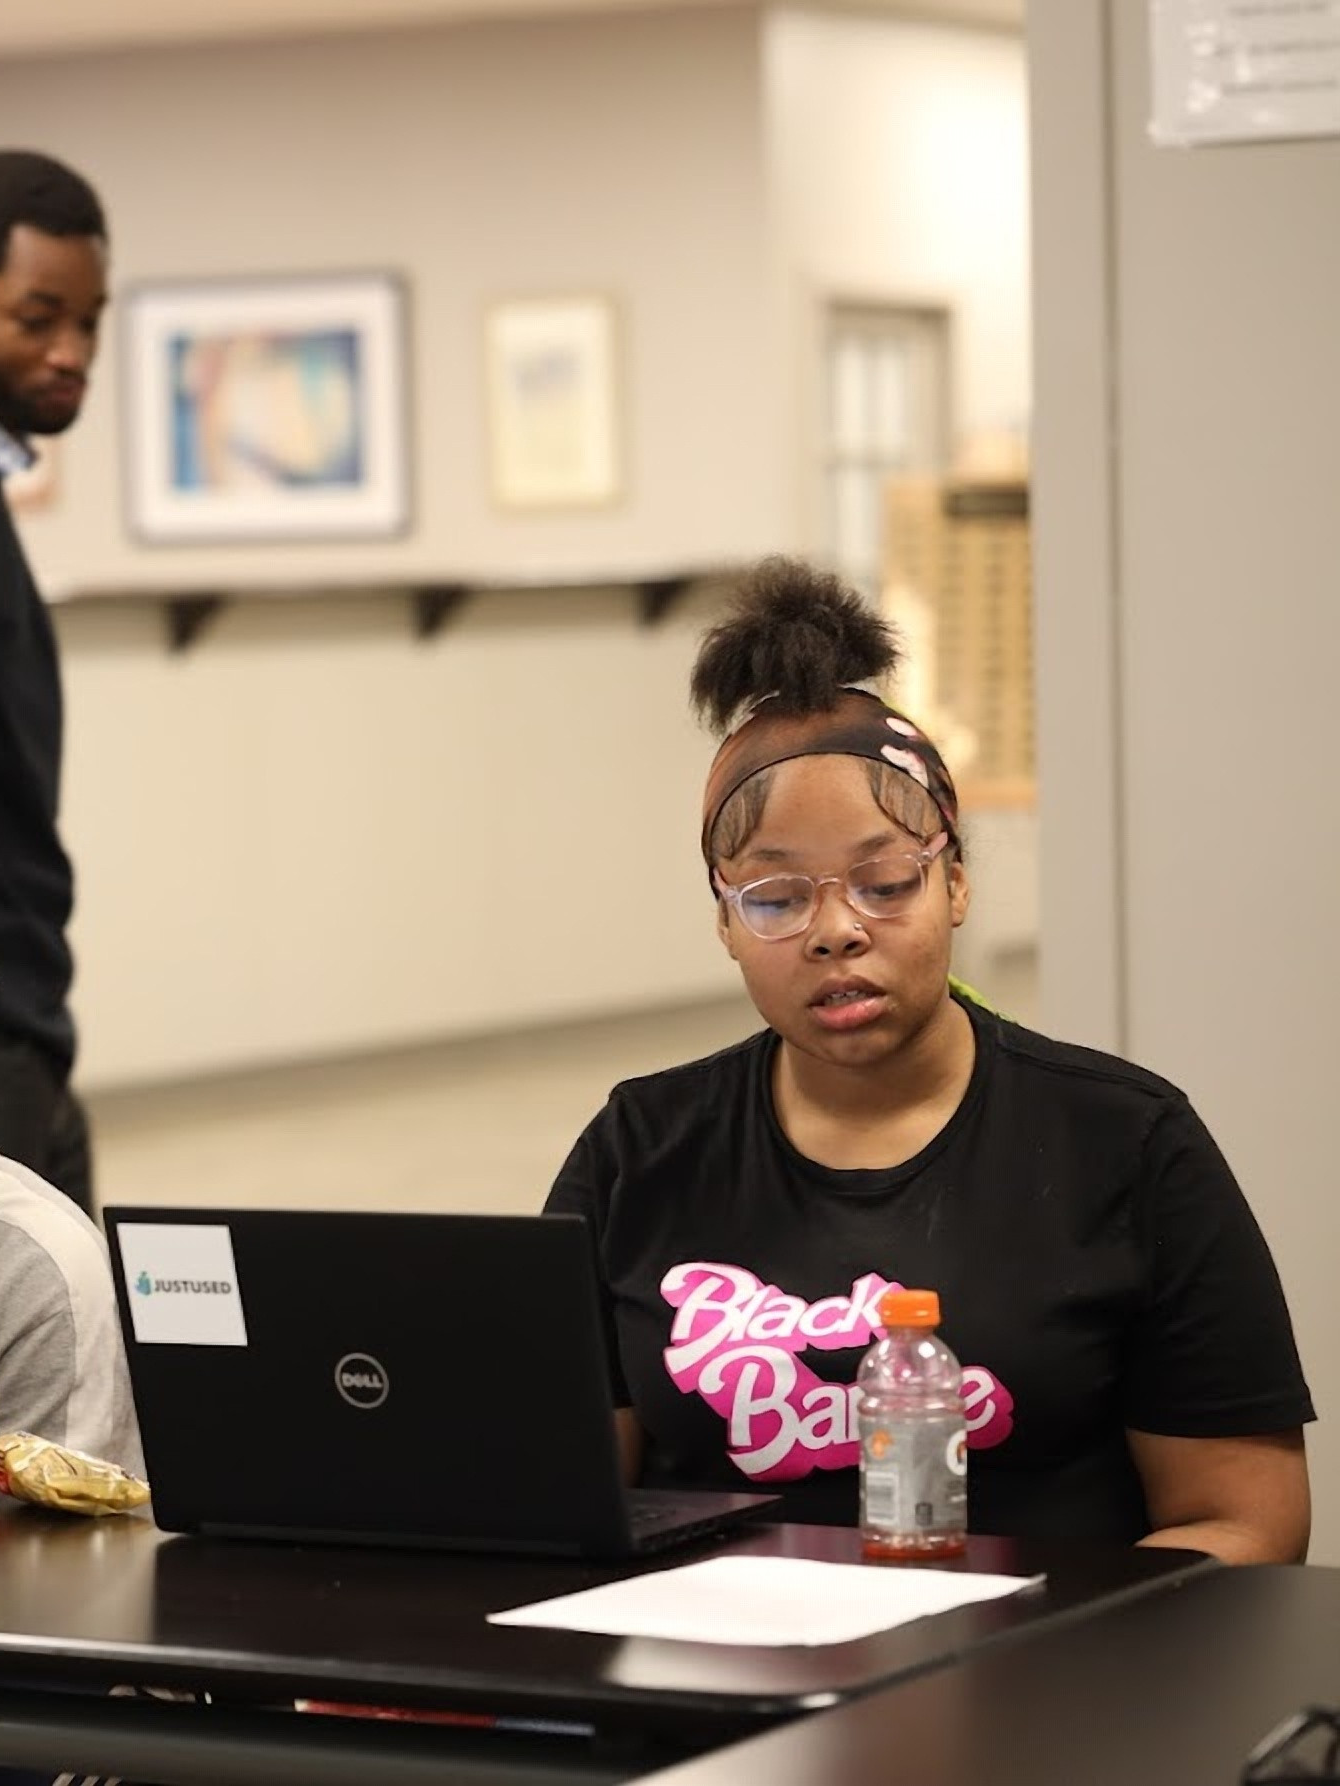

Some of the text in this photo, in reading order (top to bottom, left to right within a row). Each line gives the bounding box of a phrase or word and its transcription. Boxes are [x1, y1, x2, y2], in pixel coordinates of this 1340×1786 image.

[154, 1279, 232, 1295] JUSTUSED
[660, 1262, 884, 1374] Black
[341, 1371, 383, 1388] DELL
[698, 1344, 998, 1475] Bare
